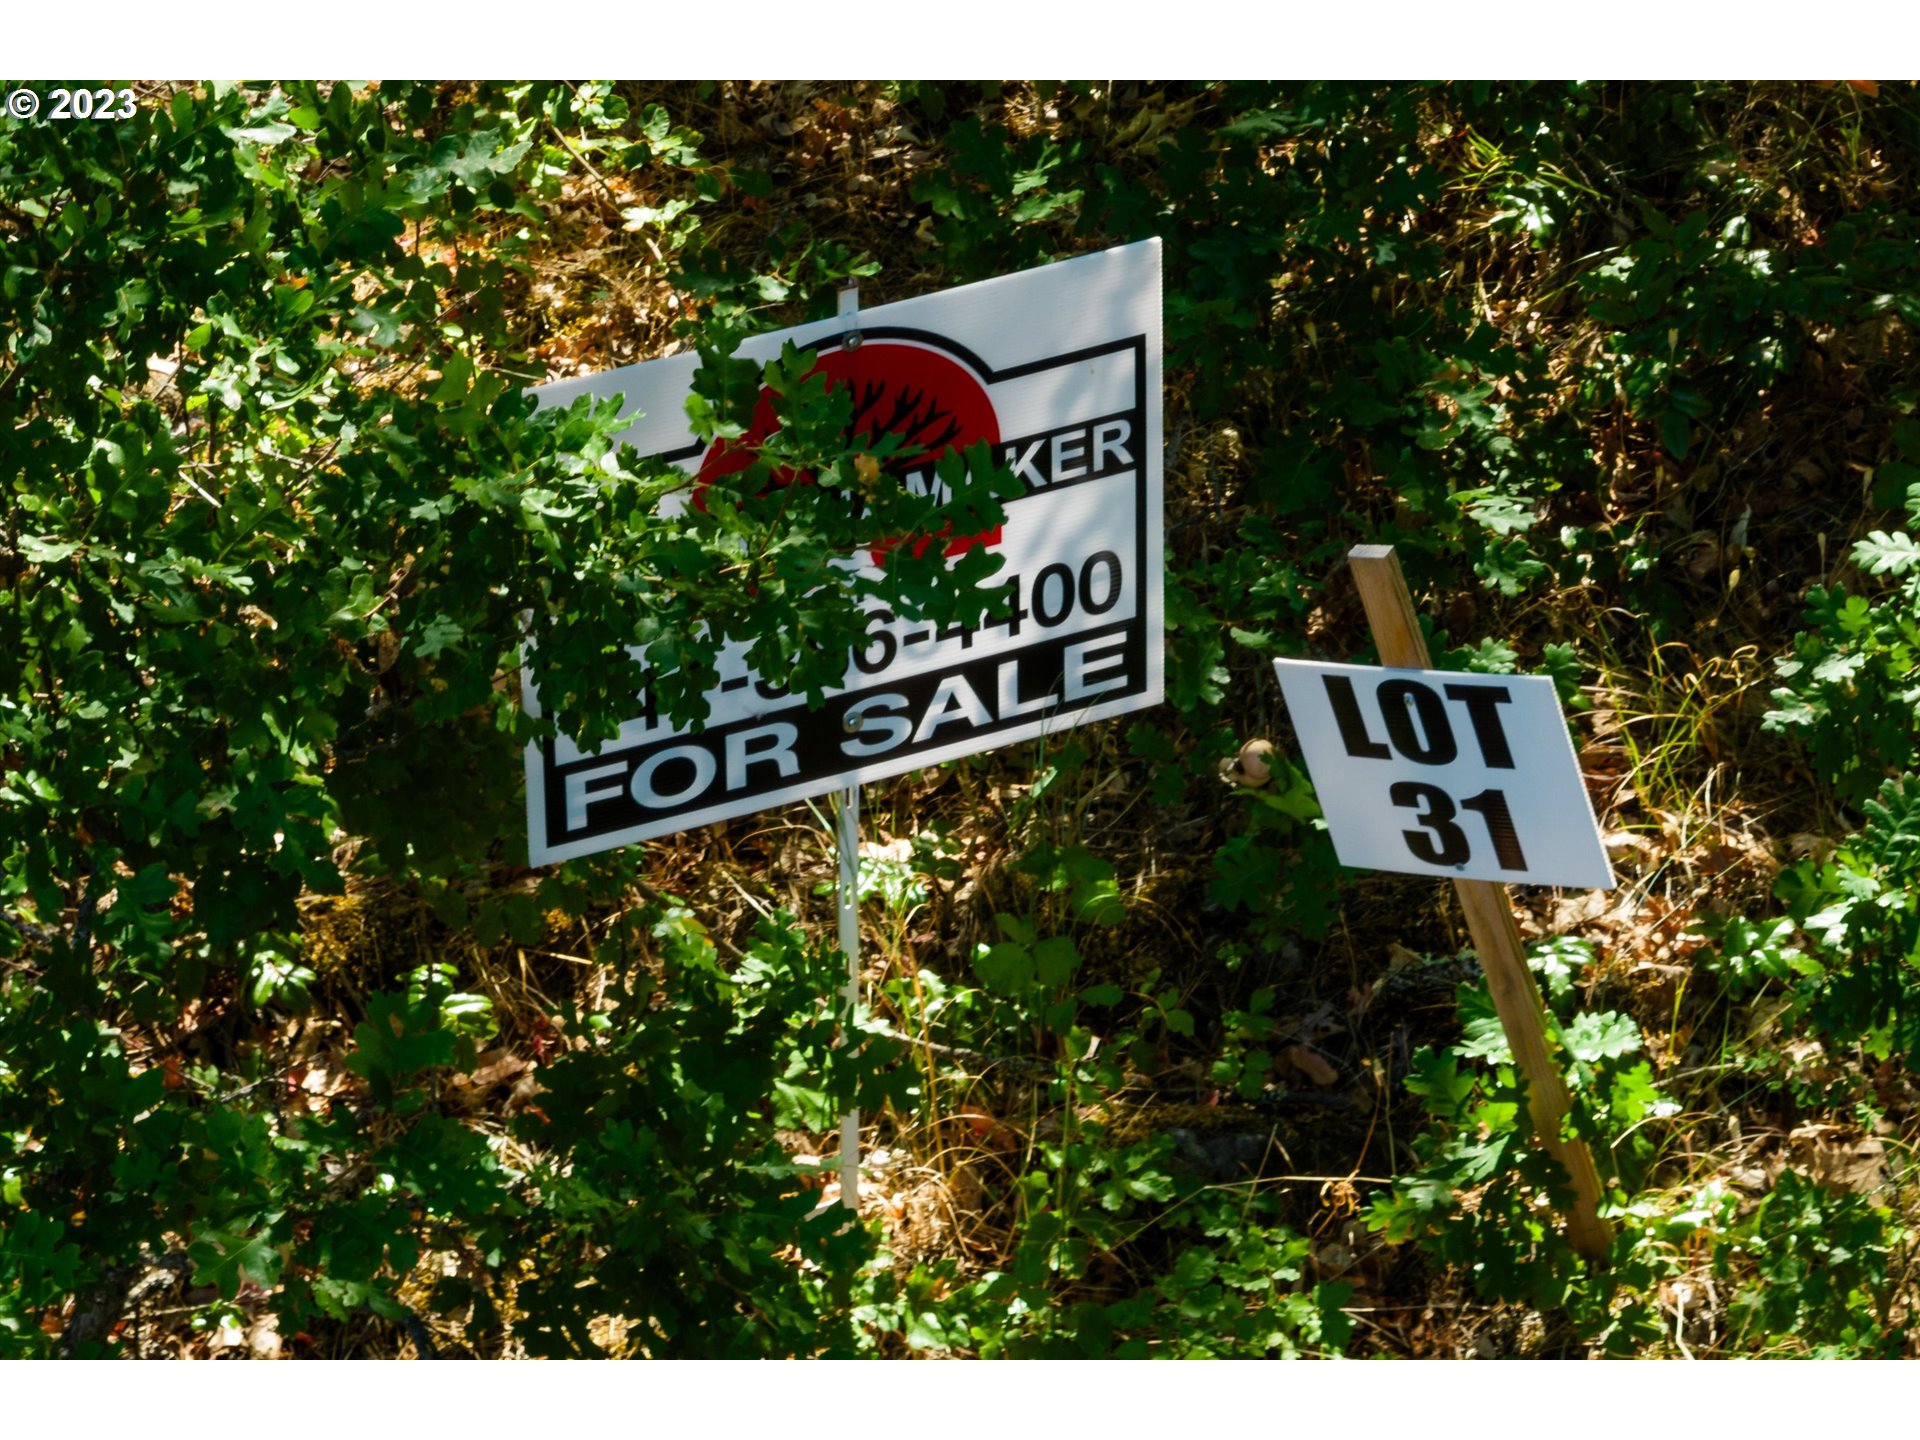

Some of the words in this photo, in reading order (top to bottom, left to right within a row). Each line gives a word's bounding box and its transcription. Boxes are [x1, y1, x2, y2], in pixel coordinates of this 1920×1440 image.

[564, 721, 800, 833] FOR
[840, 631, 1128, 757] SALE
[1321, 674, 1515, 769] LOT
[1389, 781, 1528, 872] 31
